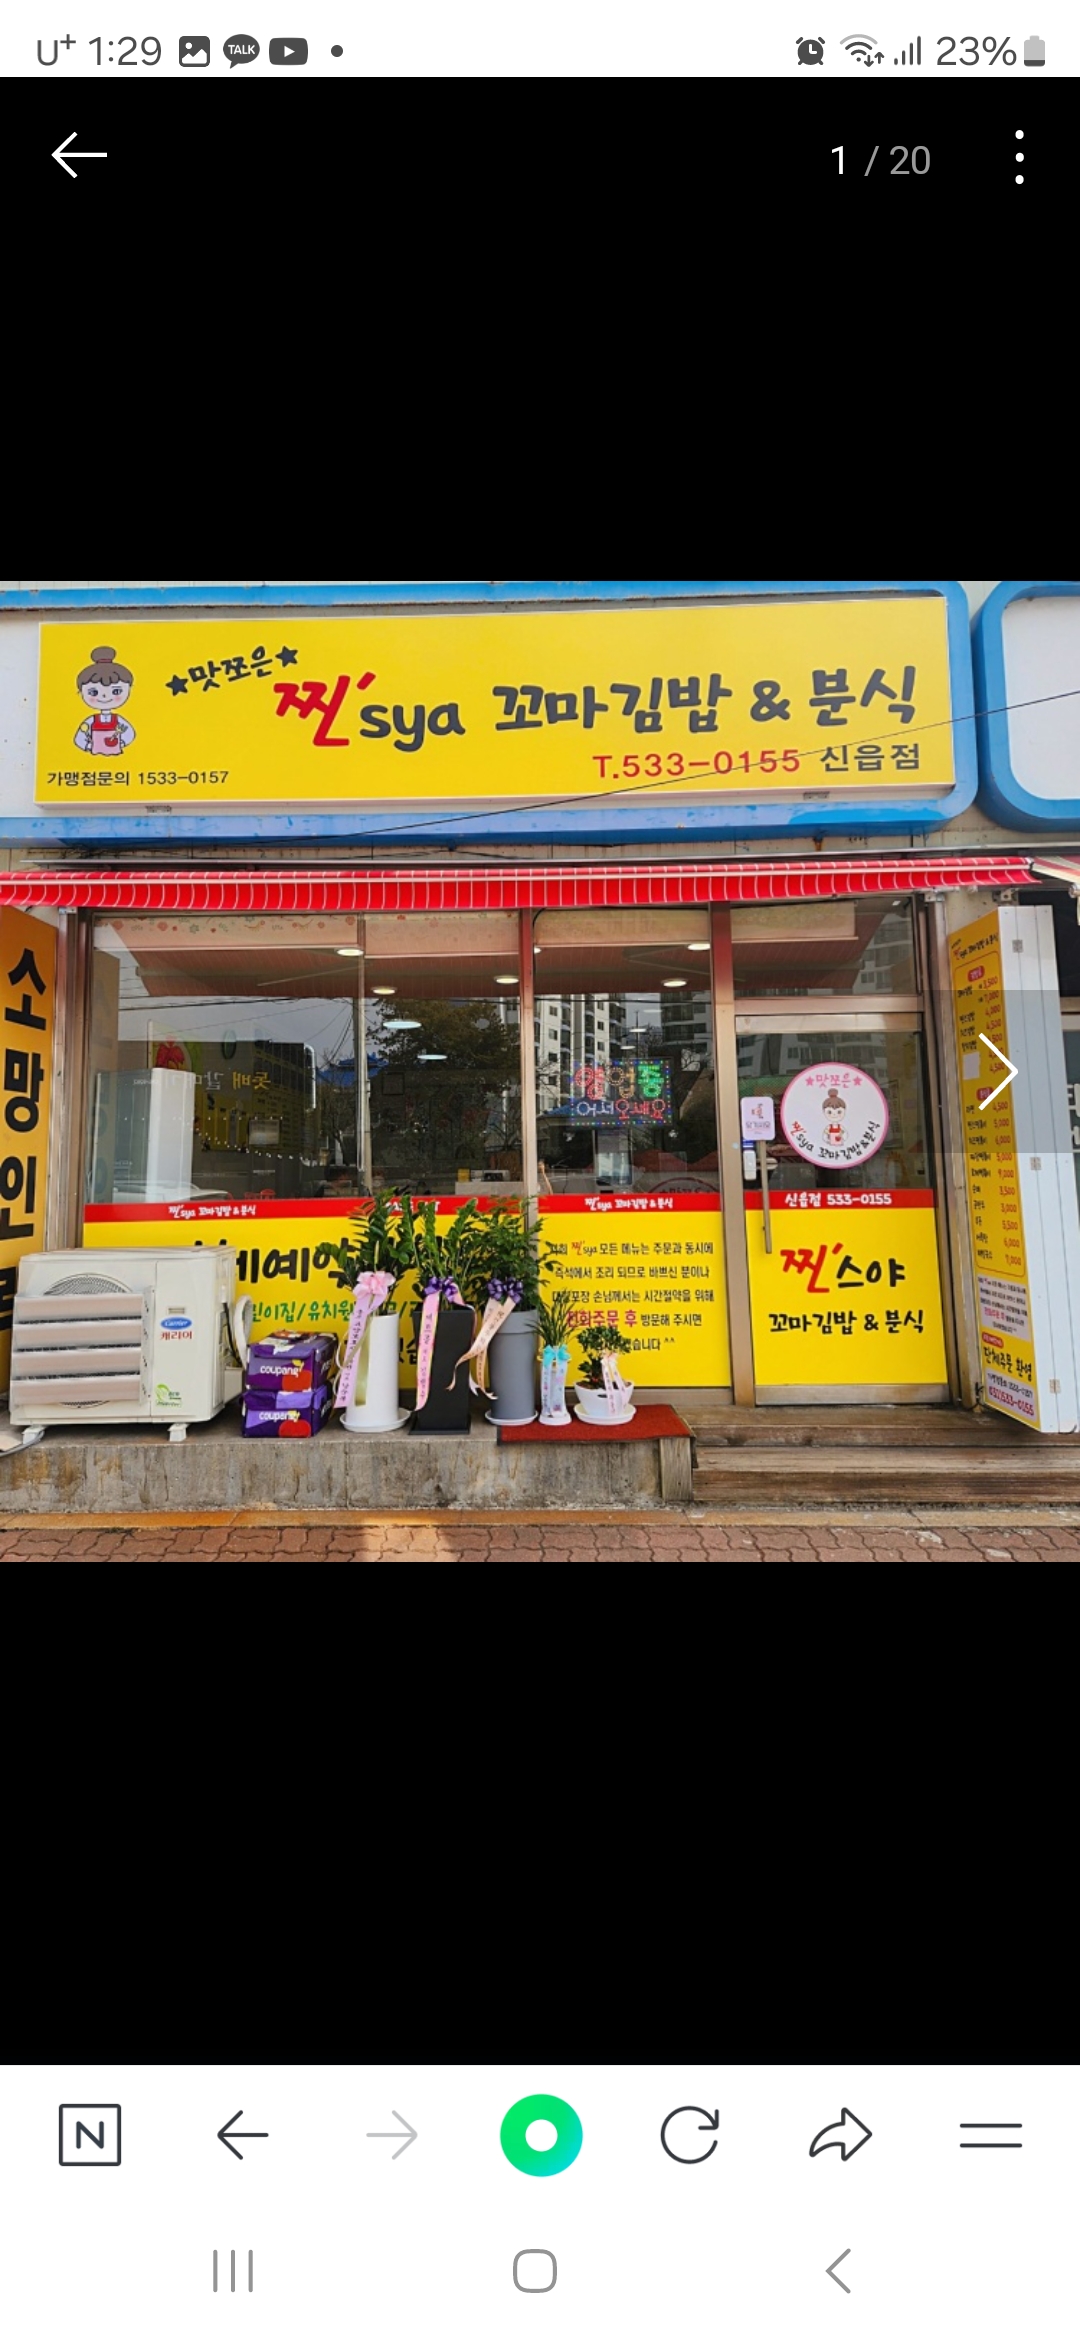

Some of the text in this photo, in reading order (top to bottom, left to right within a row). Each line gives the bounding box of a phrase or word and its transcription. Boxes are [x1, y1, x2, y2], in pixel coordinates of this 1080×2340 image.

[188, 645, 273, 692] 맛쪼은
[492, 673, 733, 733] 꼬마김밥
[749, 680, 791, 722] &
[808, 665, 917, 726] 분식
[592, 742, 921, 779] T.533-0155 신읍점
[46, 770, 229, 787] 가맹점문의 1533-0157
[573, 1064, 665, 1099] 영업중
[815, 1072, 852, 1089] 맛쪼은
[784, 1191, 892, 1208] 신읍점 533-0155
[599, 1242, 619, 1255] 모든
[621, 1242, 649, 1255] 메뉴는
[653, 1242, 682, 1255] 주문과
[685, 1241, 714, 1255] 동시에
[554, 1266, 710, 1279] 즉석에서 조리 되므로 바쁘신 분이나
[593, 1290, 641, 1303] 손님께서는
[644, 1290, 691, 1303] 시간절약을
[694, 1289, 715, 1303] 위해
[624, 1309, 638, 1327] 후
[641, 1314, 670, 1327] 방문해
[673, 1313, 702, 1327] 주시면
[768, 1309, 925, 1336] 꼬마김밥 & 분식
[260, 1364, 299, 1379] coupang
[983, 1346, 1032, 1382] 단체주문 환영
